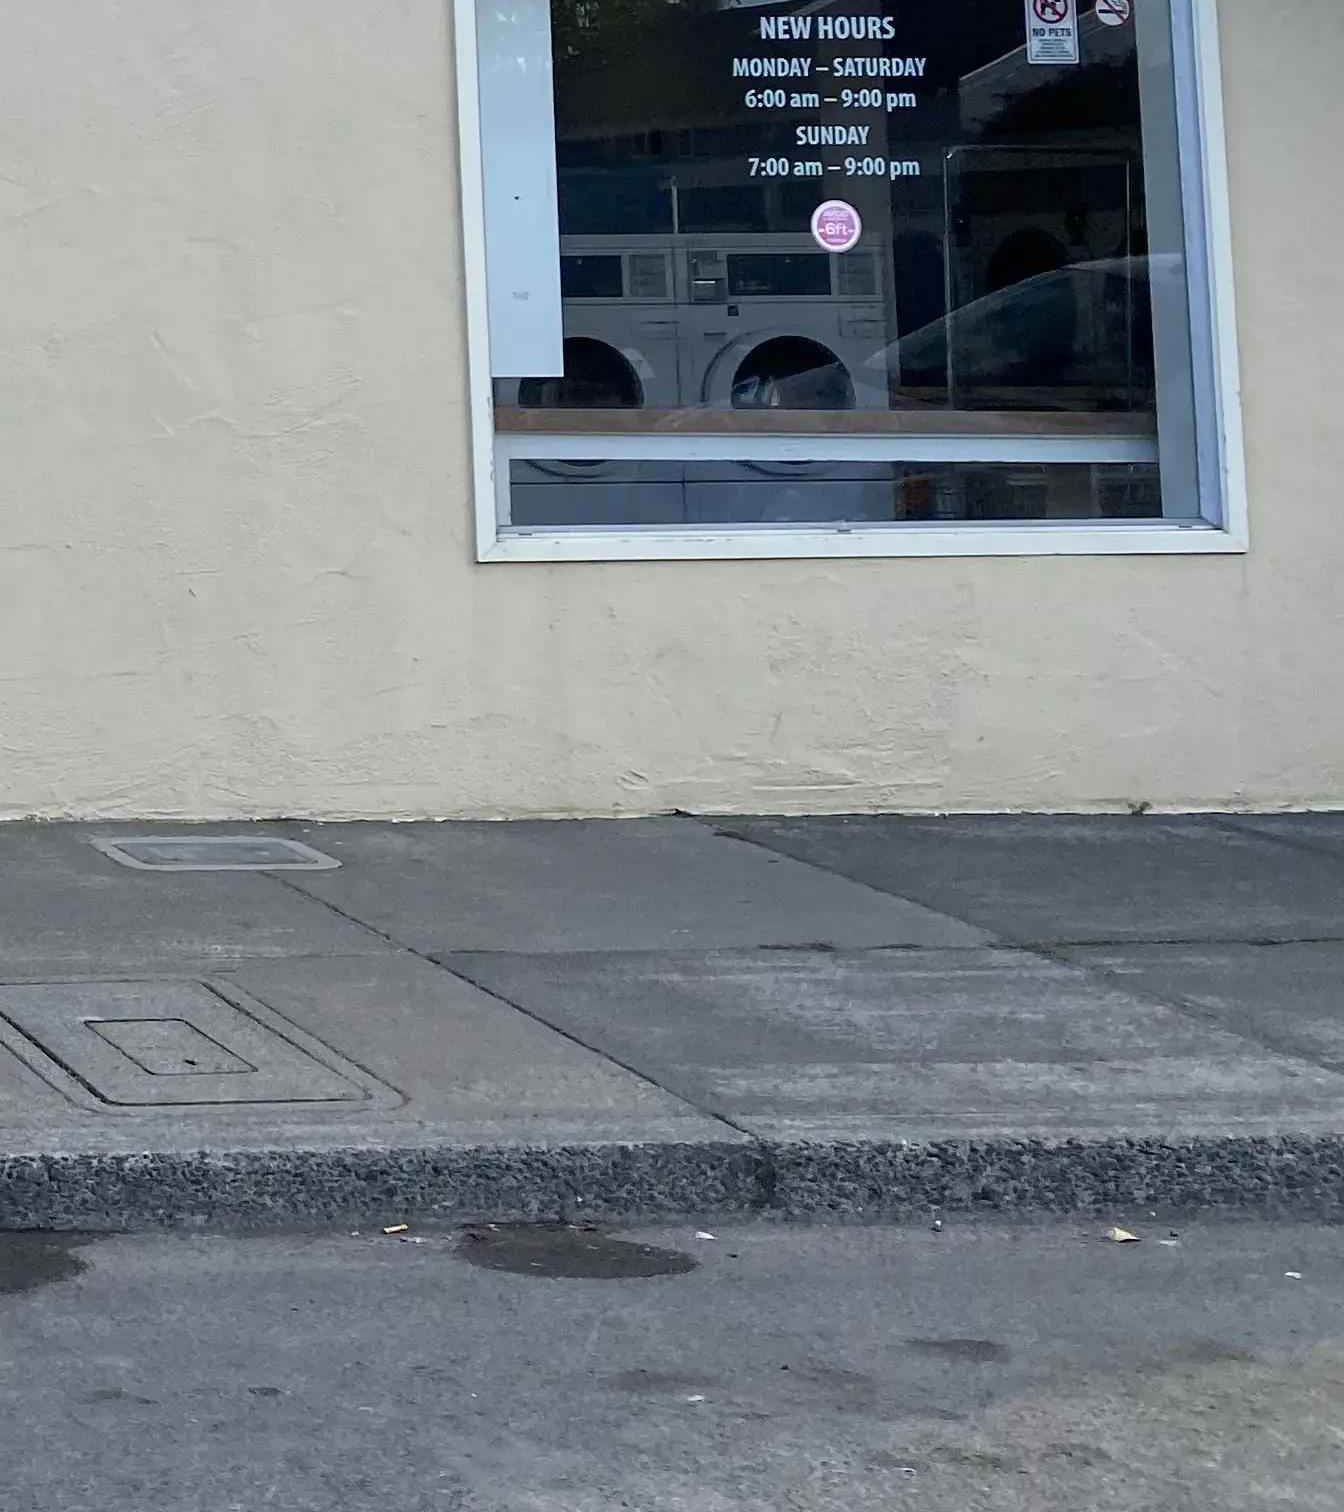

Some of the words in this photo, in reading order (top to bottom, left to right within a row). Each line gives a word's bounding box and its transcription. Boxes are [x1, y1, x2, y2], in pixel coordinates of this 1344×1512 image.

[760, 16, 812, 40] NEW
[817, 16, 896, 40] HOURS
[1032, 27, 1046, 37] NO
[1048, 27, 1072, 37] PETS
[732, 57, 812, 77] MONDAY
[832, 57, 927, 77] SATURDAY
[744, 89, 786, 108] 6:00
[790, 93, 820, 108] am
[840, 88, 883, 108] 9:00
[886, 92, 917, 112] pm
[795, 125, 870, 146] SUNDAY
[748, 157, 790, 177] 7:00
[793, 161, 824, 176] am
[844, 157, 886, 176] 9:00
[889, 161, 921, 181] pm
[825, 222, 849, 236] 6ft
